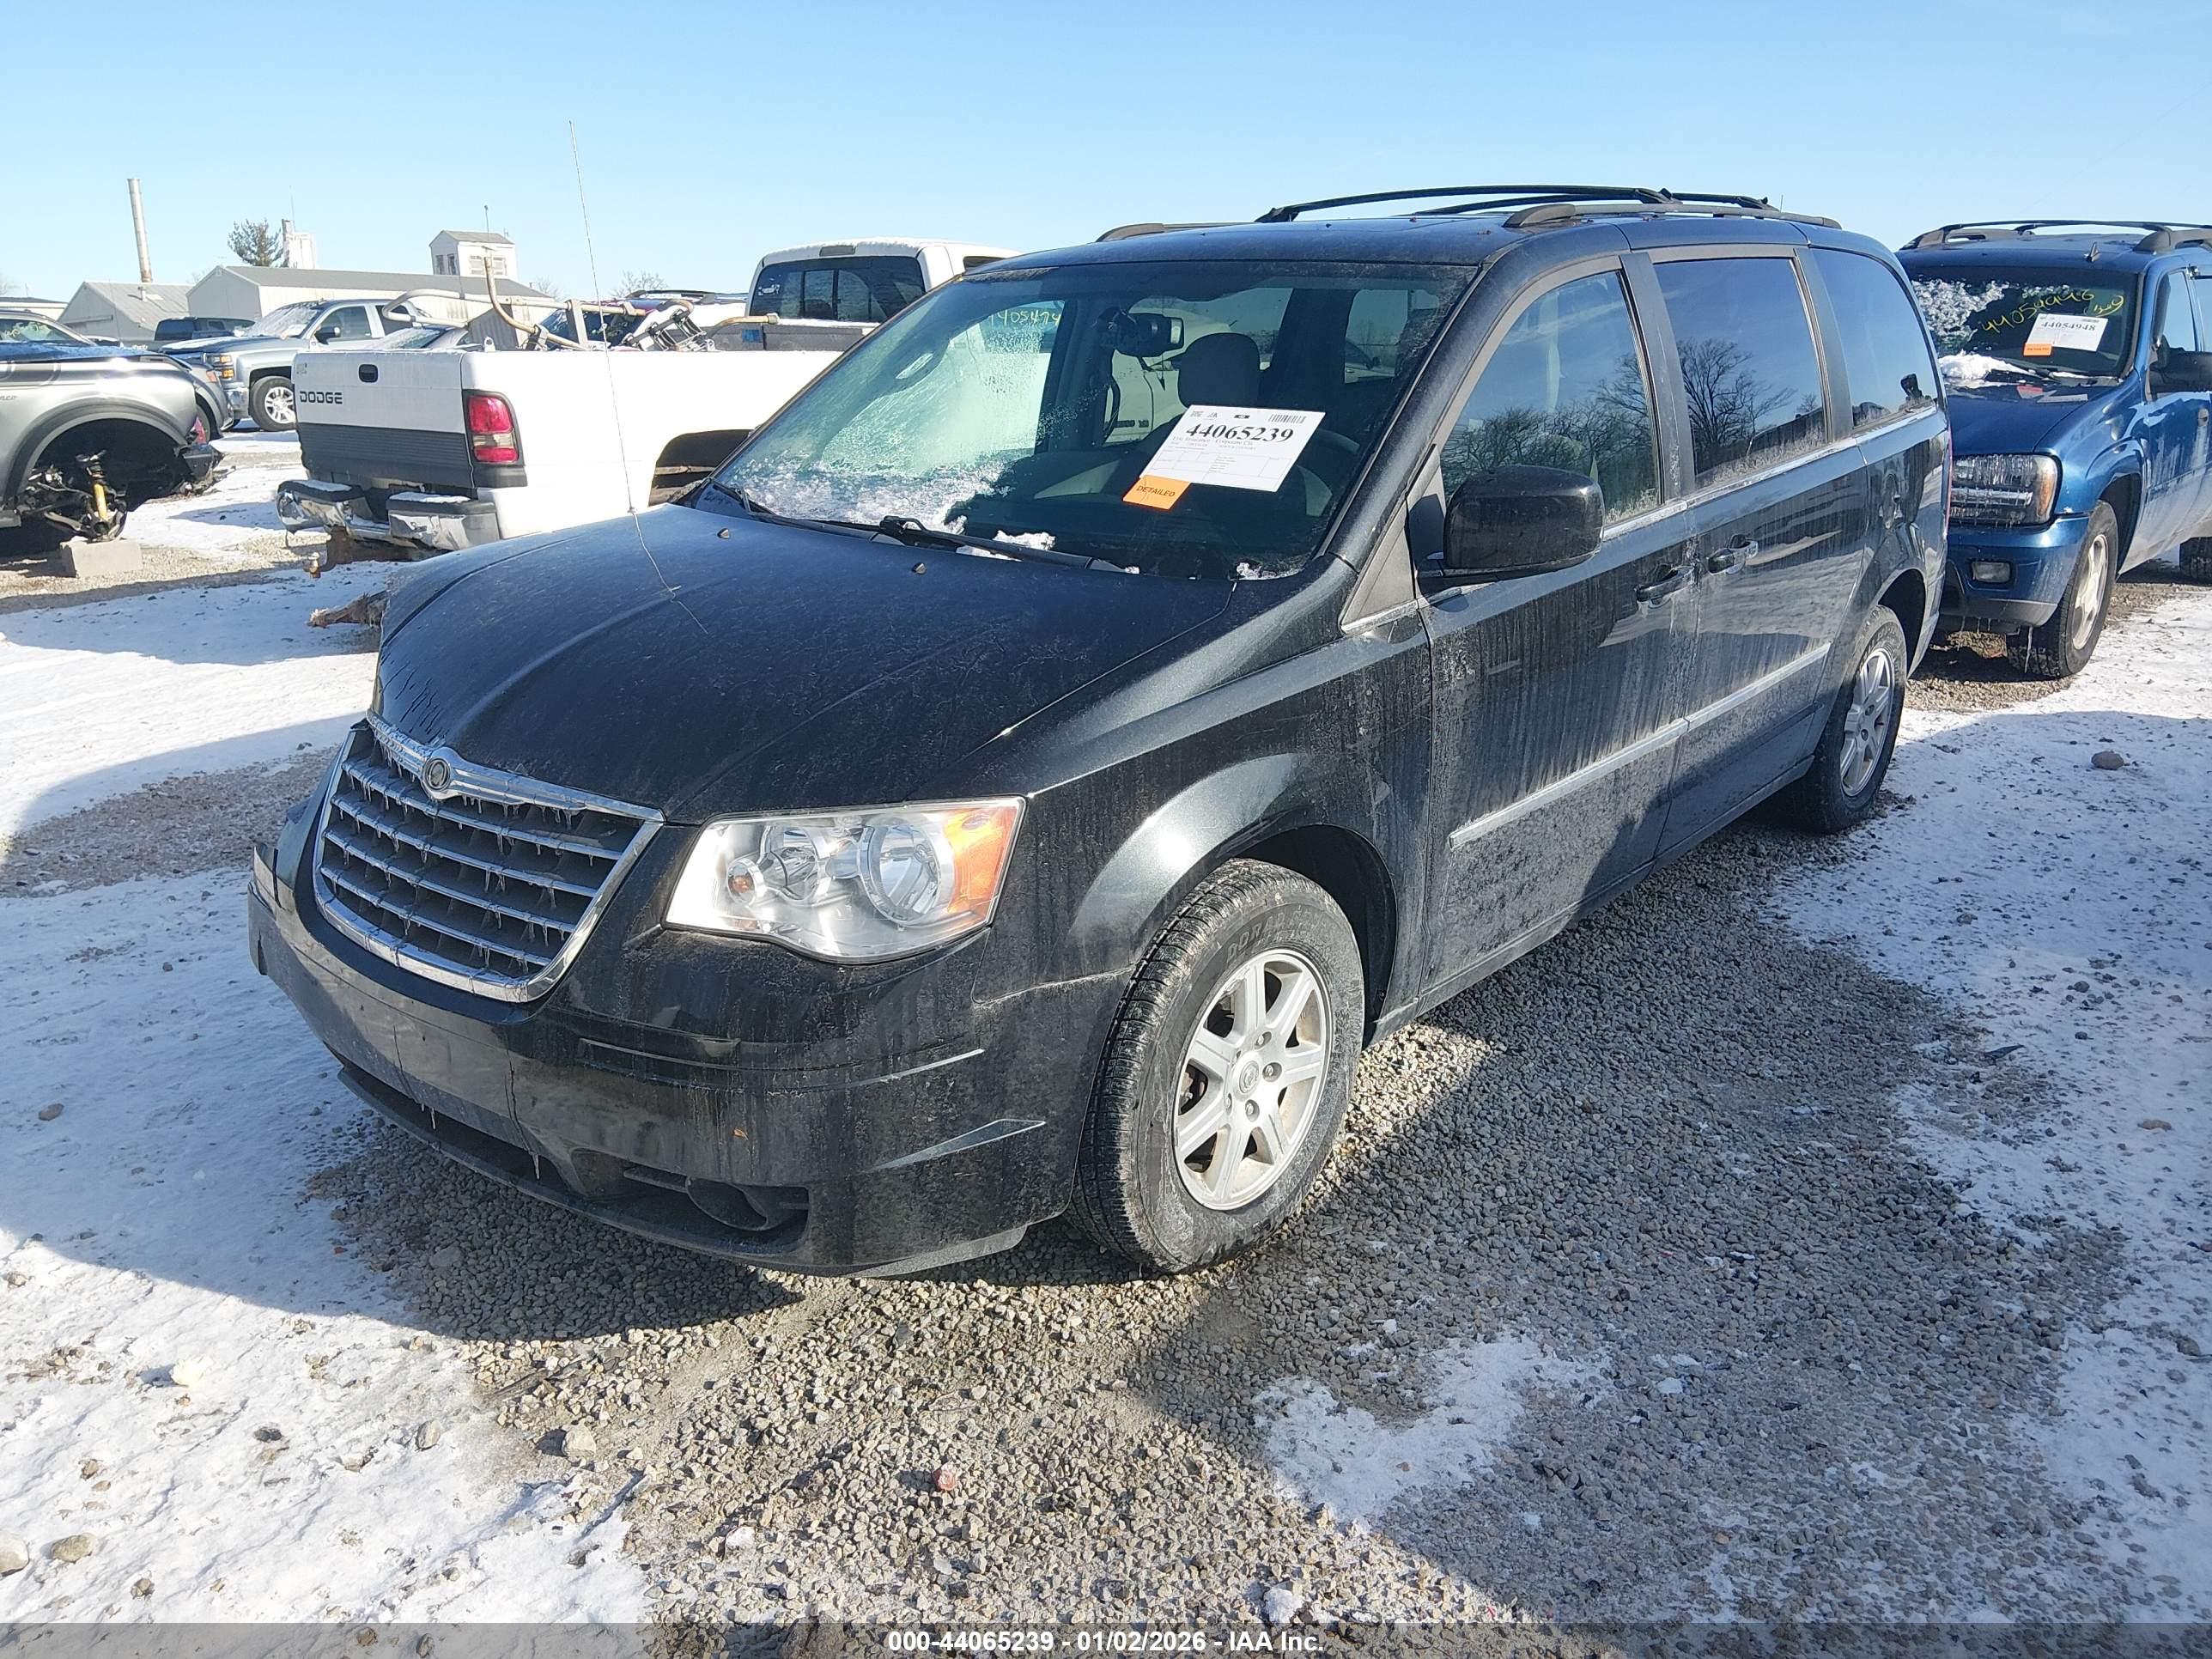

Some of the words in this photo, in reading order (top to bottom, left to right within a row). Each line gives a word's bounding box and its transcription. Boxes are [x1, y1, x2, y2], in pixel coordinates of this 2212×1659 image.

[2040, 321, 2096, 331] 44054948
[299, 391, 343, 404] DODGE
[1185, 422, 1294, 443] 44065239
[1136, 484, 1176, 497] DETAILED
